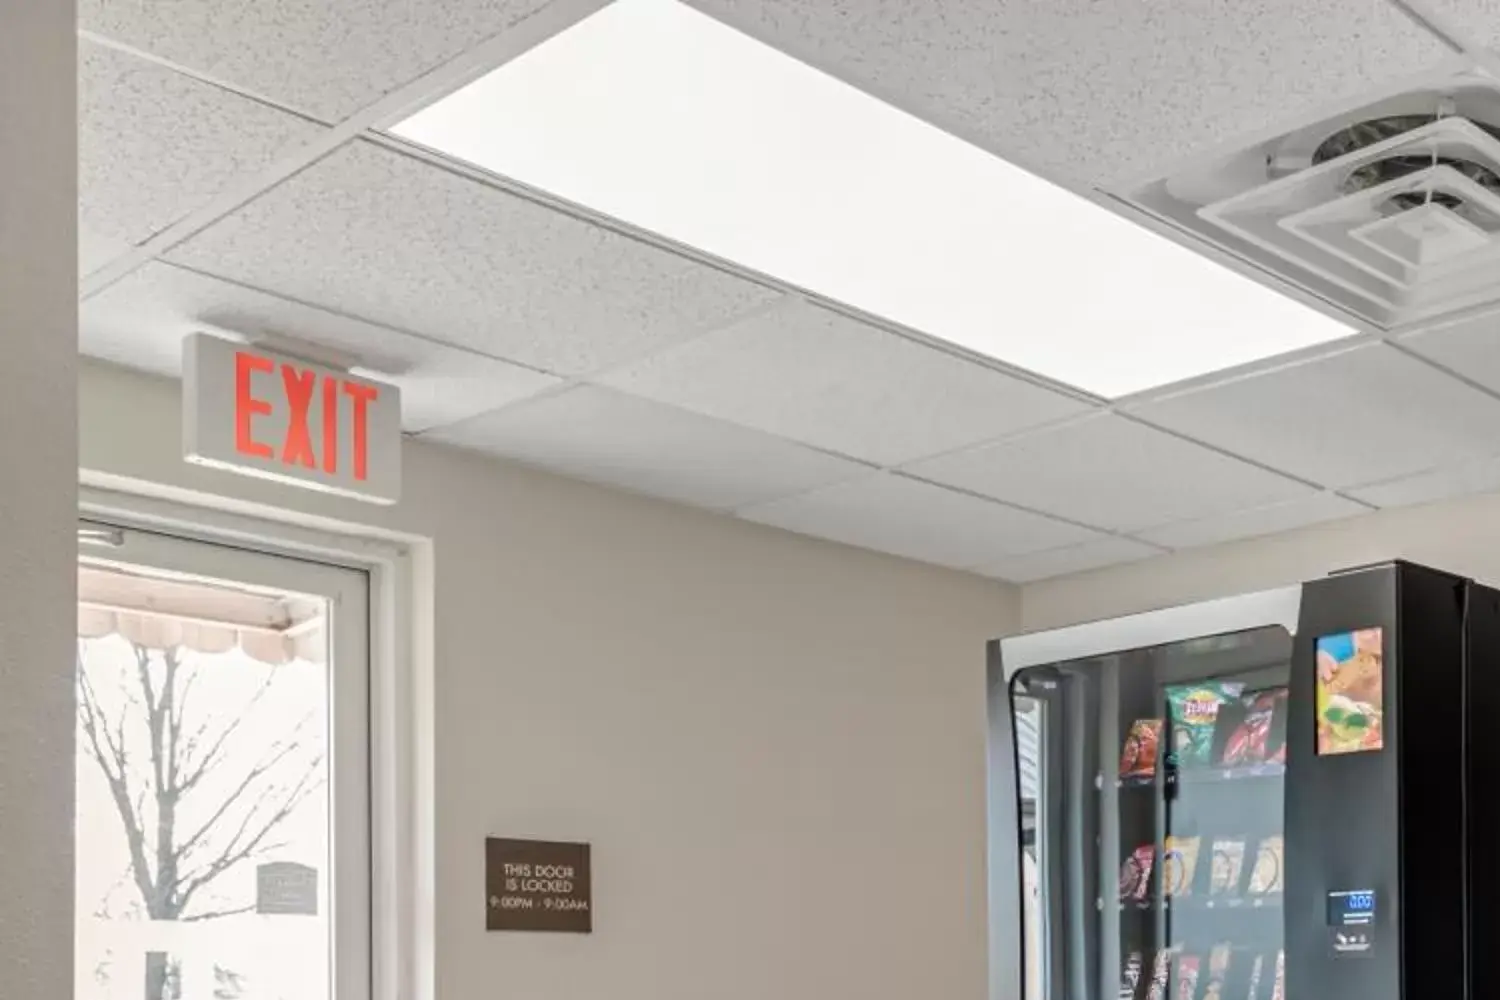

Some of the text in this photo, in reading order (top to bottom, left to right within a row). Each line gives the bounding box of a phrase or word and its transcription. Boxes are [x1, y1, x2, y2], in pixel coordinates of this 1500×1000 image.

[235, 351, 379, 481] EXIT
[504, 863, 574, 878] THIS DOOR
[505, 878, 574, 893] IS LOCKED
